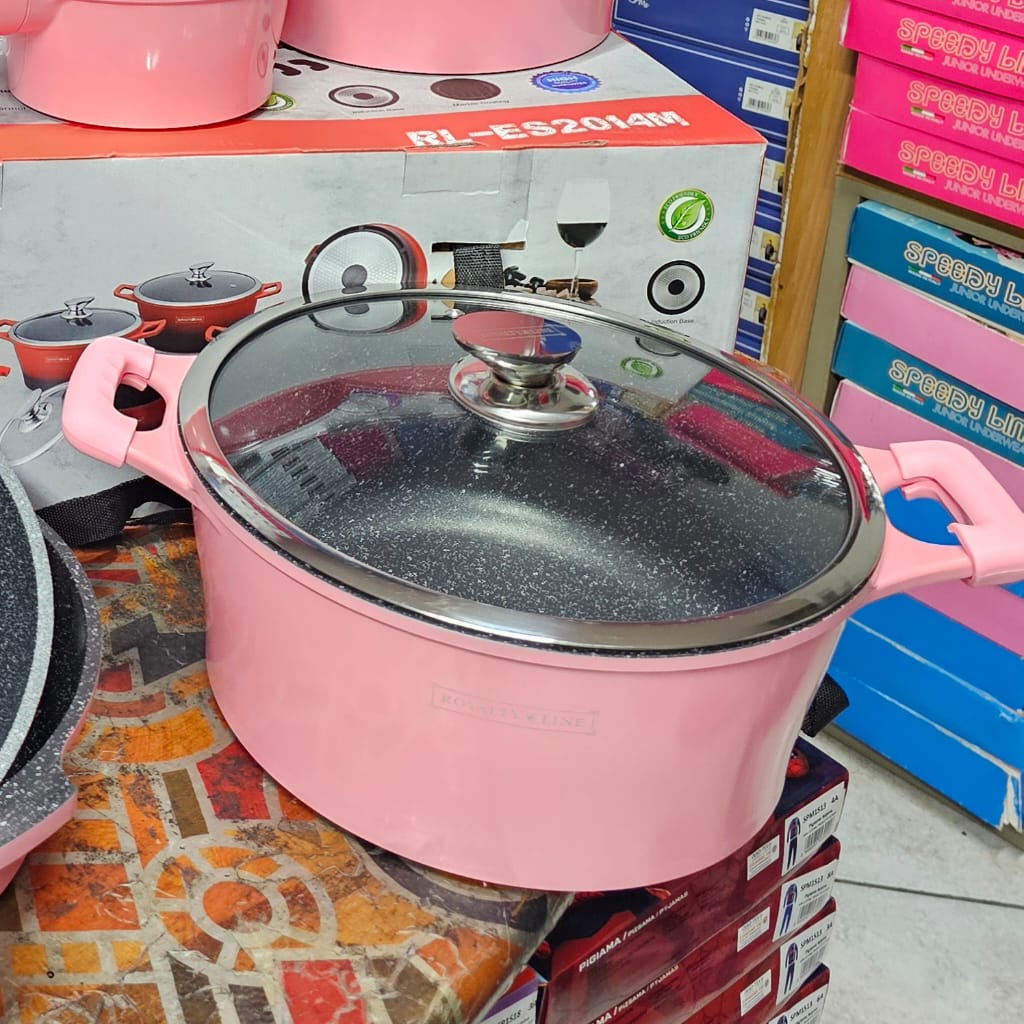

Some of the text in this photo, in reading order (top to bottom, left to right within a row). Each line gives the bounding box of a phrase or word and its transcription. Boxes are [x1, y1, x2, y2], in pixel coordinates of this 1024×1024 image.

[897, 18, 997, 64] SPEEDY
[942, 55, 980, 75] JUNIOR
[907, 80, 1005, 128] SPEEDY
[406, 109, 690, 147] RL-ES2014M
[952, 119, 990, 139] JUNIOR
[898, 140, 995, 190] SPEEDY
[943, 179, 982, 200] JUNIOR
[904, 240, 1002, 297] SPEEDY
[949, 282, 987, 307] JUNIOR
[888, 359, 986, 420] SPEEDY
[932, 402, 970, 427] JUNIOR
[579, 936, 622, 973] PIGIAMA
